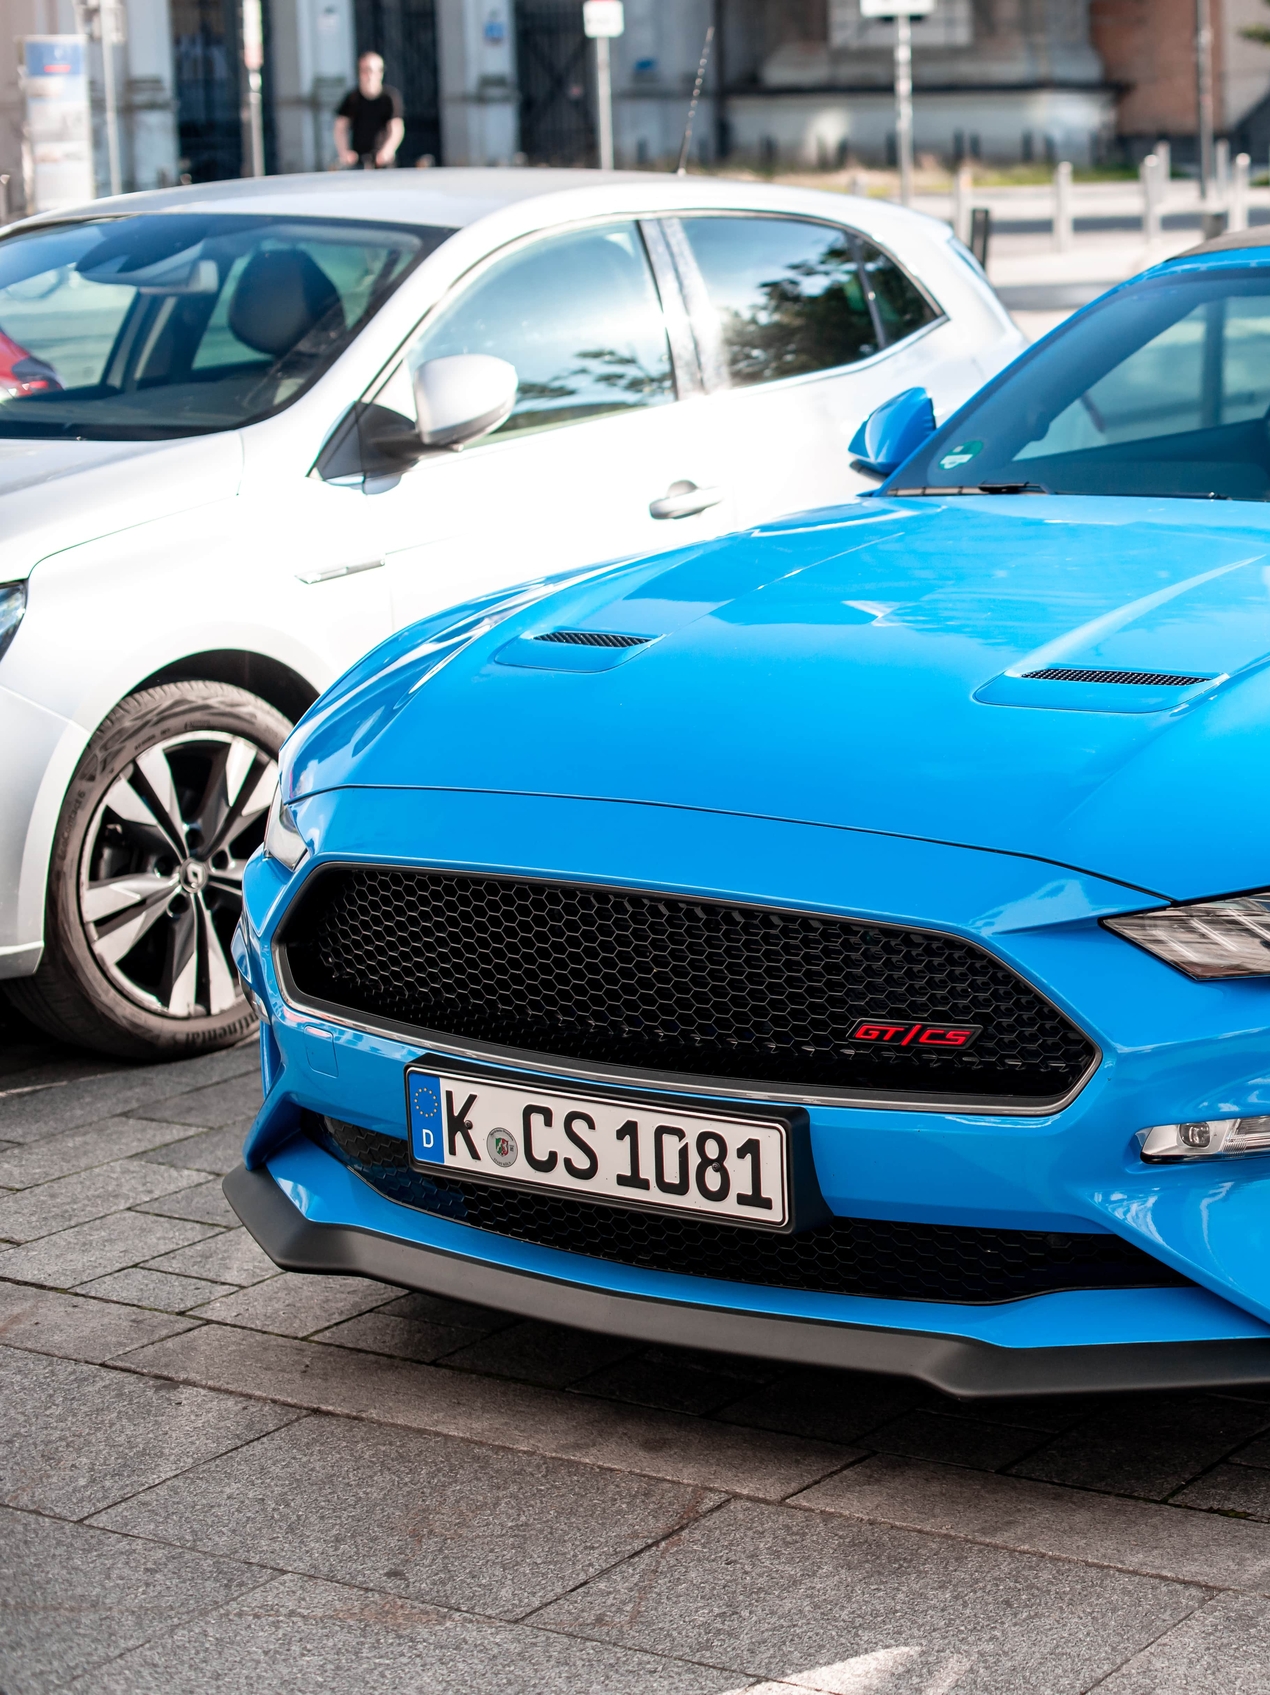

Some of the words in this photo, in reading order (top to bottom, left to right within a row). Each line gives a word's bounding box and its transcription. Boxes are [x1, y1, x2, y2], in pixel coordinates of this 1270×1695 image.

[422, 1128, 434, 1149] D
[445, 1090, 482, 1161] K
[522, 1103, 599, 1181] CS
[615, 1119, 774, 1211] 1081
